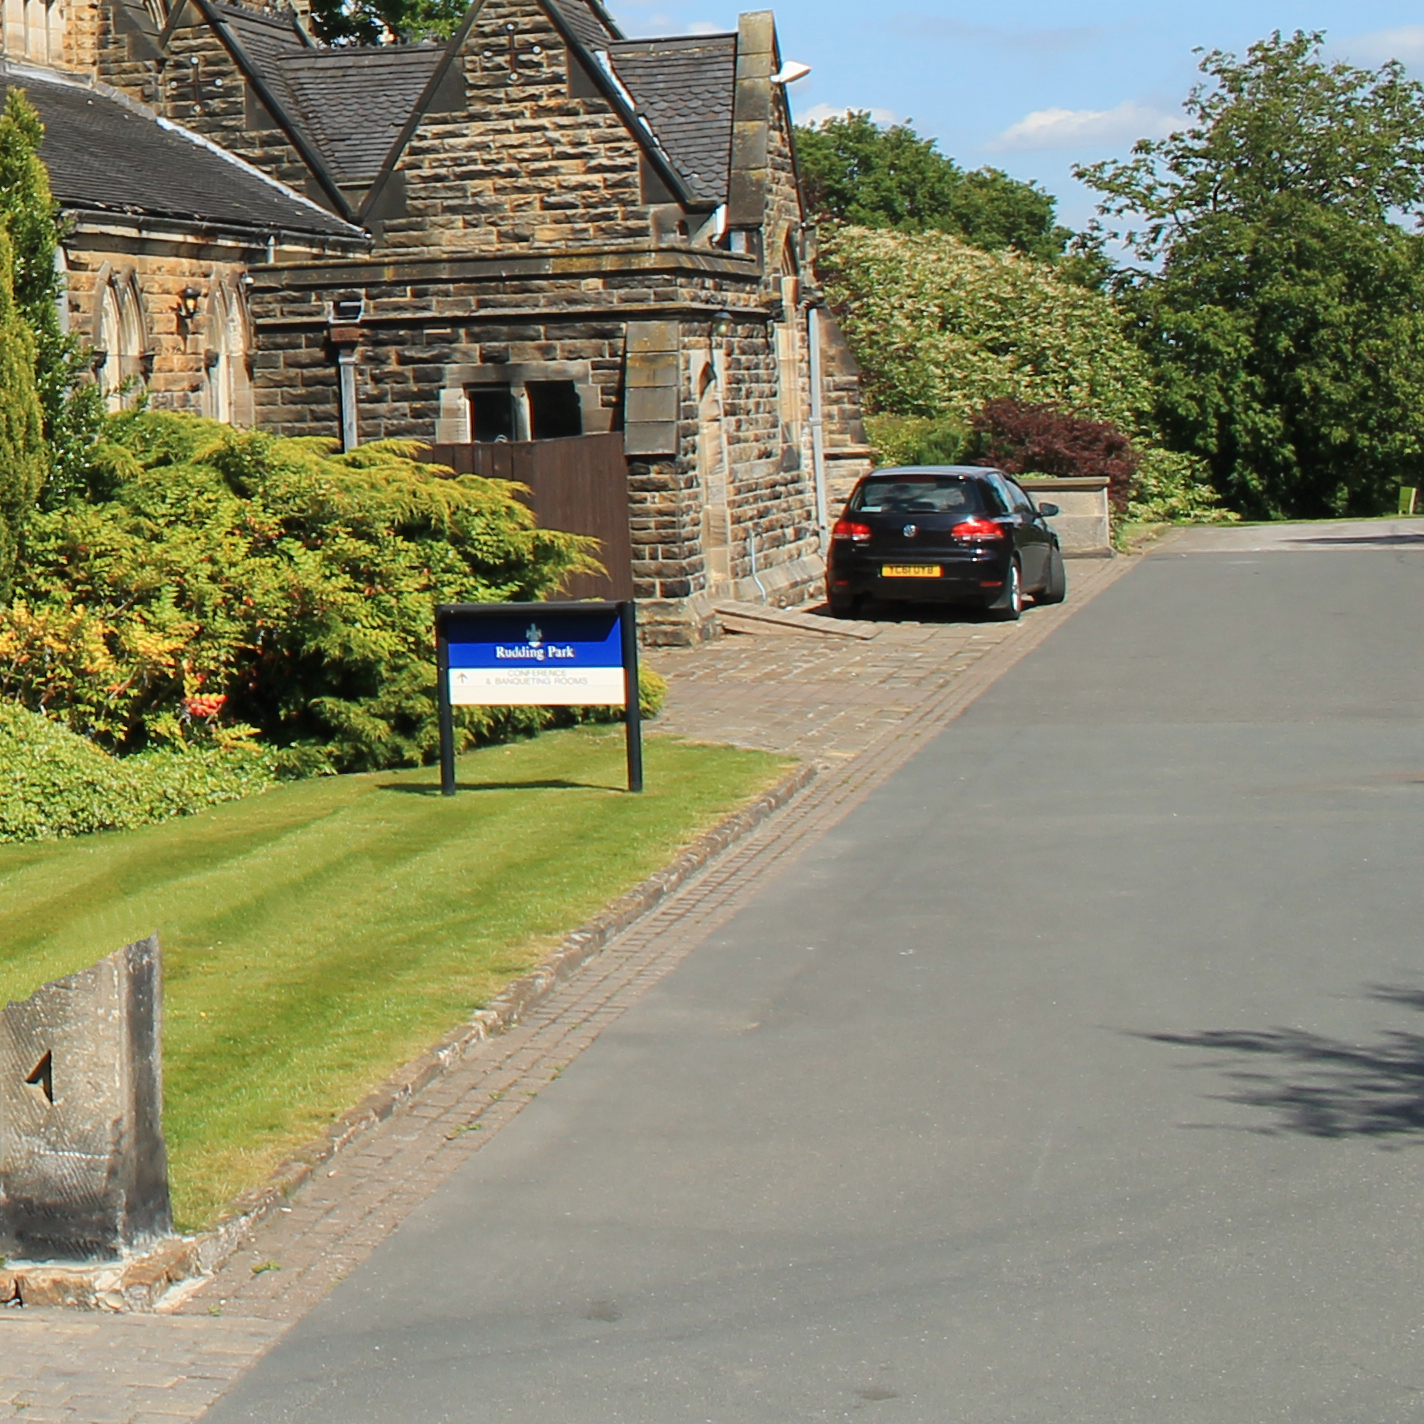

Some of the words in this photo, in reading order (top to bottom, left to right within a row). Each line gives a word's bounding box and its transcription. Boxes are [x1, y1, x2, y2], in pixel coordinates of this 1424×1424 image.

[495, 645, 545, 661] Rudding
[547, 645, 575, 658] Park
[507, 669, 566, 677] CONFERENCE
[495, 677, 551, 685] BANQUETING
[554, 677, 588, 685] ROOMS
